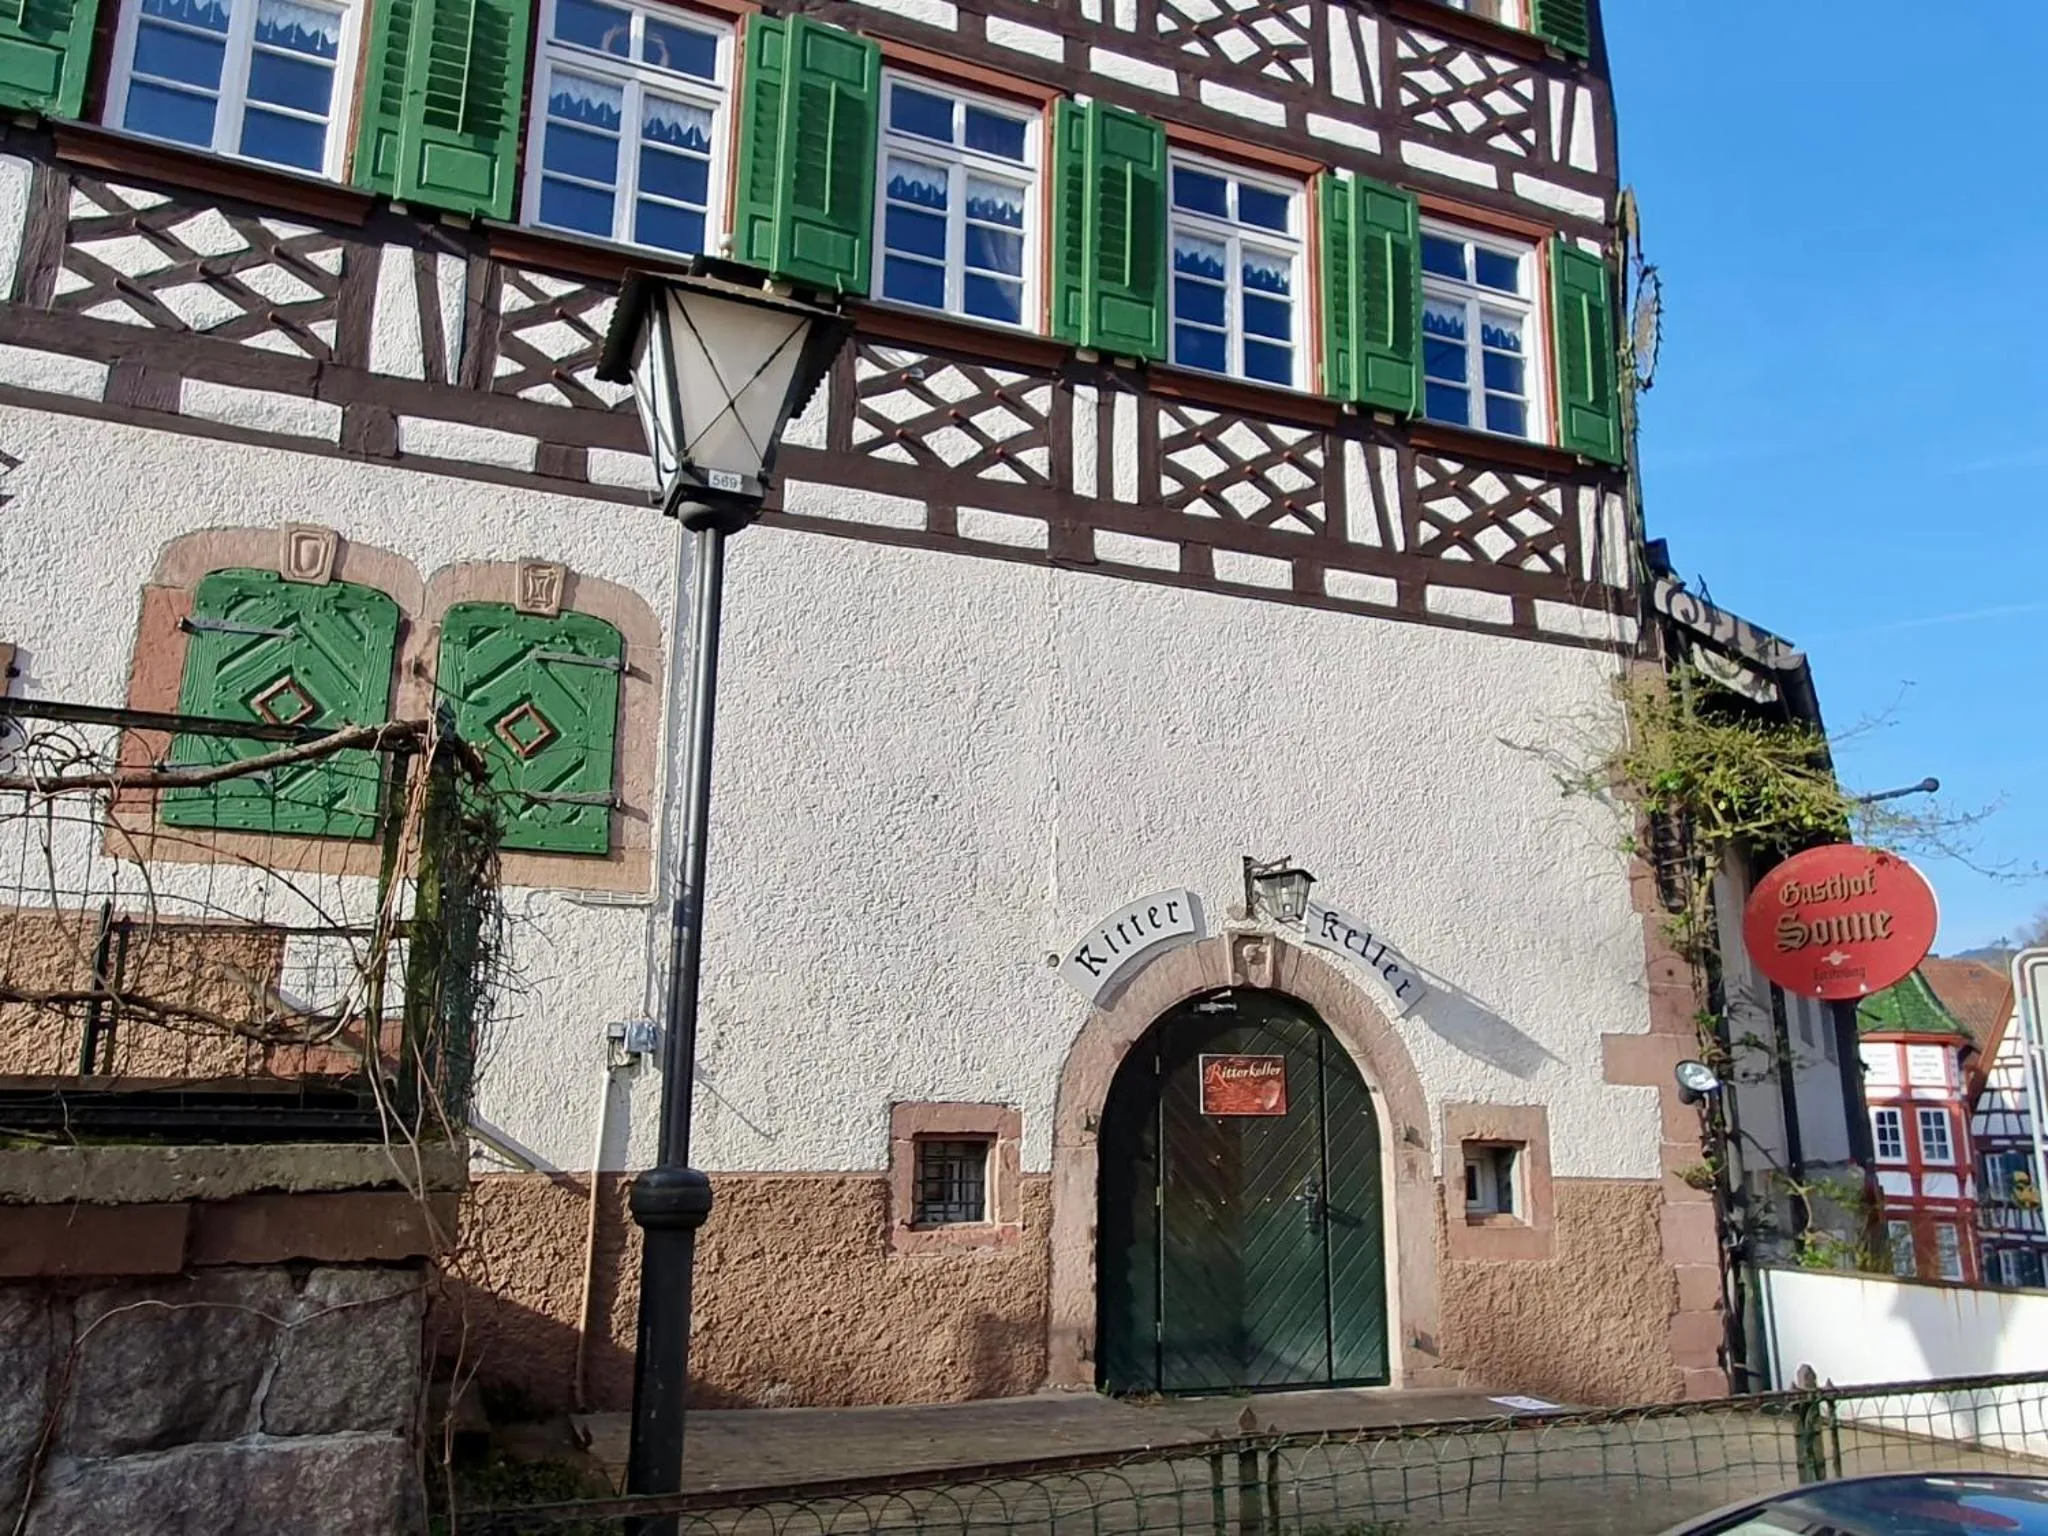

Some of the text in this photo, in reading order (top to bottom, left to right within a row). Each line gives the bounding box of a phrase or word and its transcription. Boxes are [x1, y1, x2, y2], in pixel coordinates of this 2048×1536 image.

[712, 474, 738, 488] 569
[1780, 868, 1876, 907] Gasthof
[1075, 901, 1411, 998] Ritter Keller
[1775, 909, 1893, 952] Sonne
[1204, 1062, 1281, 1088] Ritterkeller
